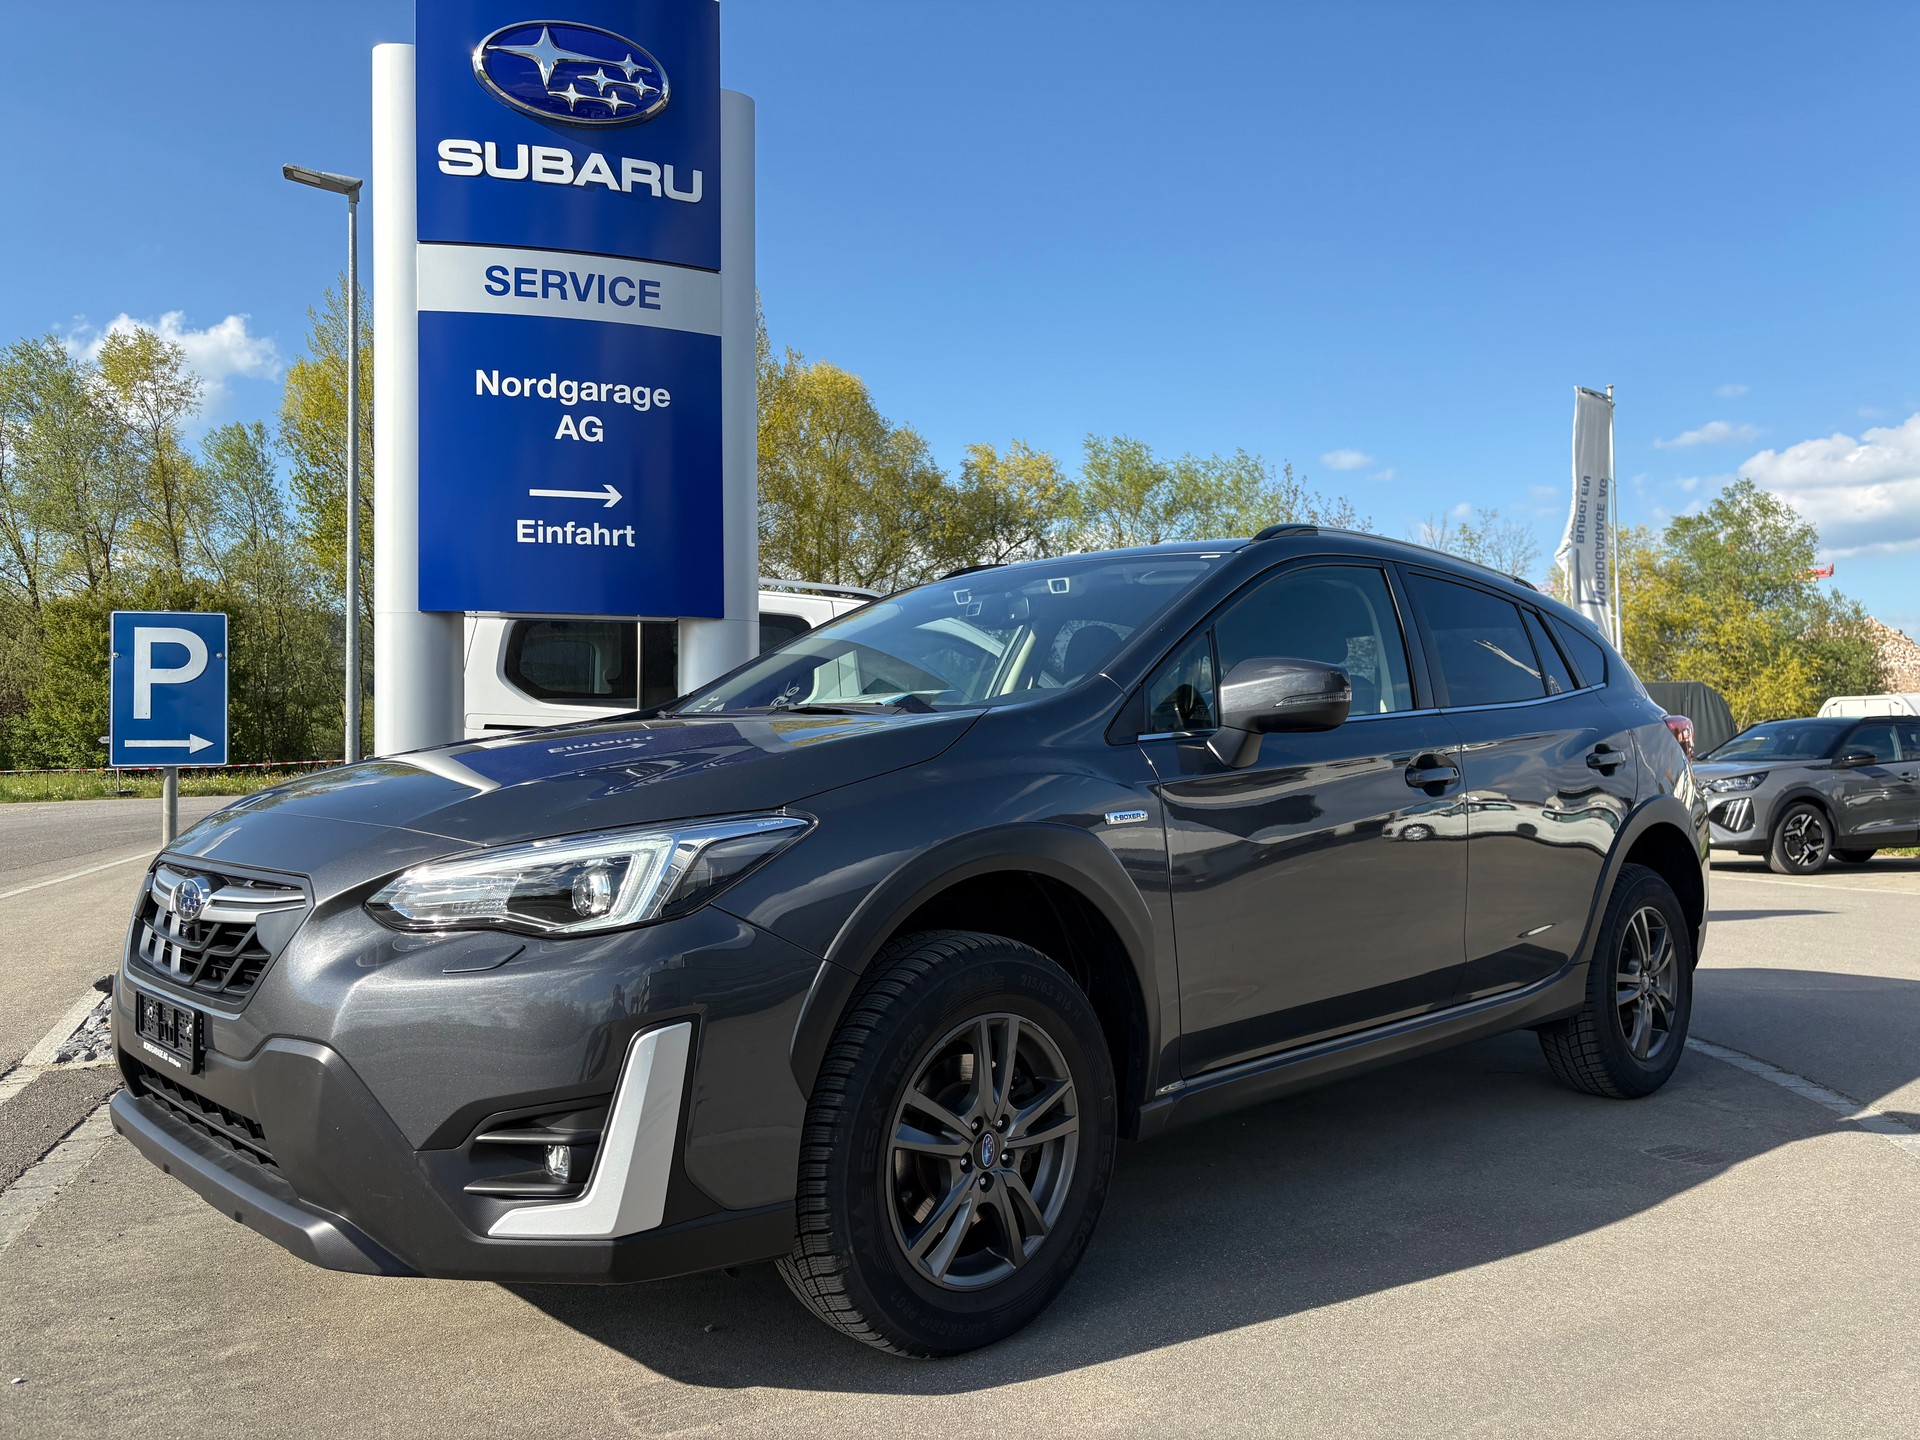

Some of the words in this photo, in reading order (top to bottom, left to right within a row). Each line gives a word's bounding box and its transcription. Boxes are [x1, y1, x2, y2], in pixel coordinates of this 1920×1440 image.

[437, 138, 704, 205] SUBARU
[483, 265, 662, 311] SERVICE
[475, 369, 671, 409] Nordgarage
[554, 415, 605, 443] AG
[515, 519, 636, 548] Einfahrt
[133, 626, 209, 720] P
